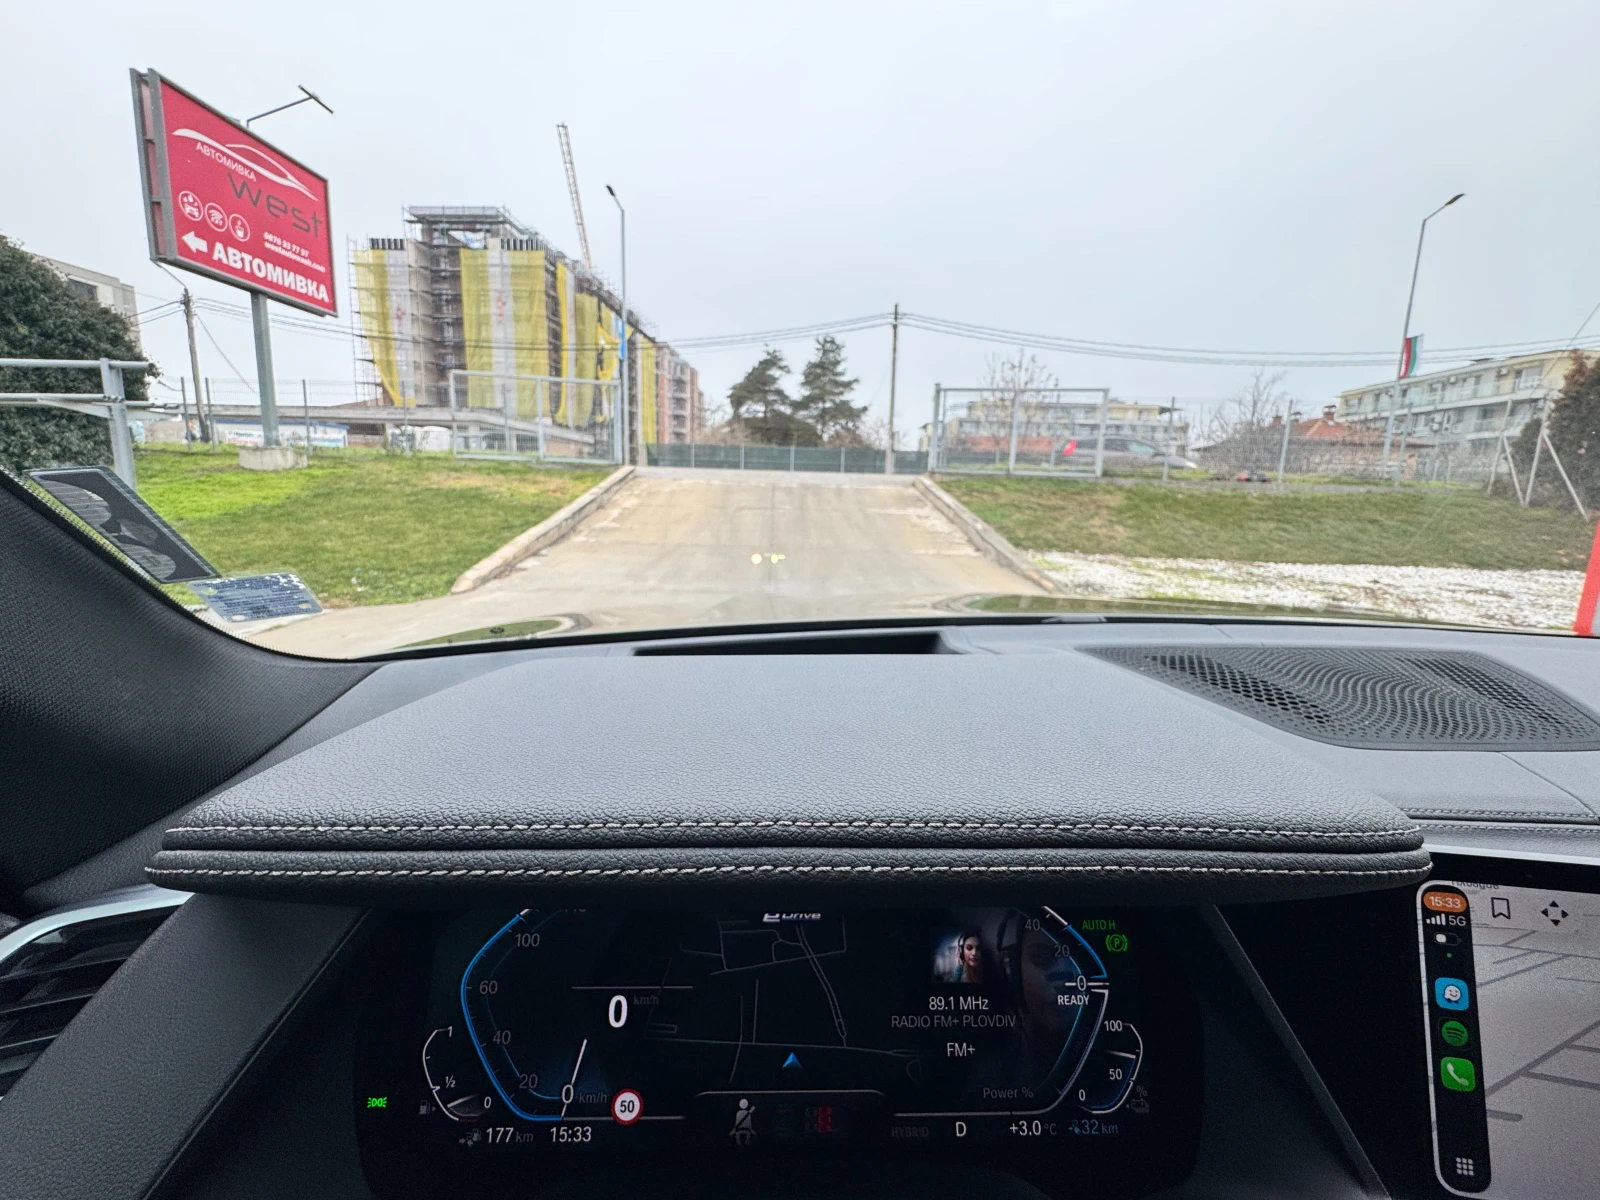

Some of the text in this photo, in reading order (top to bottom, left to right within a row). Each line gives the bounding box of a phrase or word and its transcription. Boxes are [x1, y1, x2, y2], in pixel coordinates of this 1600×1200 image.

[195, 141, 257, 183] АВТОМИВКА
[227, 172, 322, 238] west
[213, 242, 330, 303] АВТОМИВКА
[1428, 895, 1461, 909] 15:33
[1025, 918, 1041, 932] 40
[1082, 919, 1116, 931] AUTO H
[1448, 915, 1467, 927] 5G
[515, 933, 541, 948] 100
[1054, 944, 1070, 958] 20
[479, 980, 498, 995] 60
[1076, 974, 1087, 991] 0
[928, 996, 989, 1011] 89.1 MHz
[1057, 994, 1090, 1006] READY
[607, 994, 629, 1029] 0
[891, 1014, 1017, 1028] RADIO FM+ PLOVDIV
[1104, 1019, 1123, 1033] 100
[493, 1029, 512, 1045] 40
[946, 1042, 976, 1057] FM+
[519, 1074, 539, 1090] 20
[1109, 1068, 1123, 1081] 50
[561, 1083, 608, 1104] 0 km/h
[983, 1086, 1034, 1099] Power %
[1078, 1089, 1086, 1102] 0
[483, 1096, 492, 1109] 0
[619, 1100, 635, 1114] 50
[486, 1127, 534, 1143] 177 km
[549, 1126, 592, 1142] 15:33
[891, 1126, 930, 1138] HYBRID
[955, 1121, 967, 1137] D
[1009, 1120, 1058, 1137] +3.0 °C
[1081, 1120, 1119, 1135] 32 km
